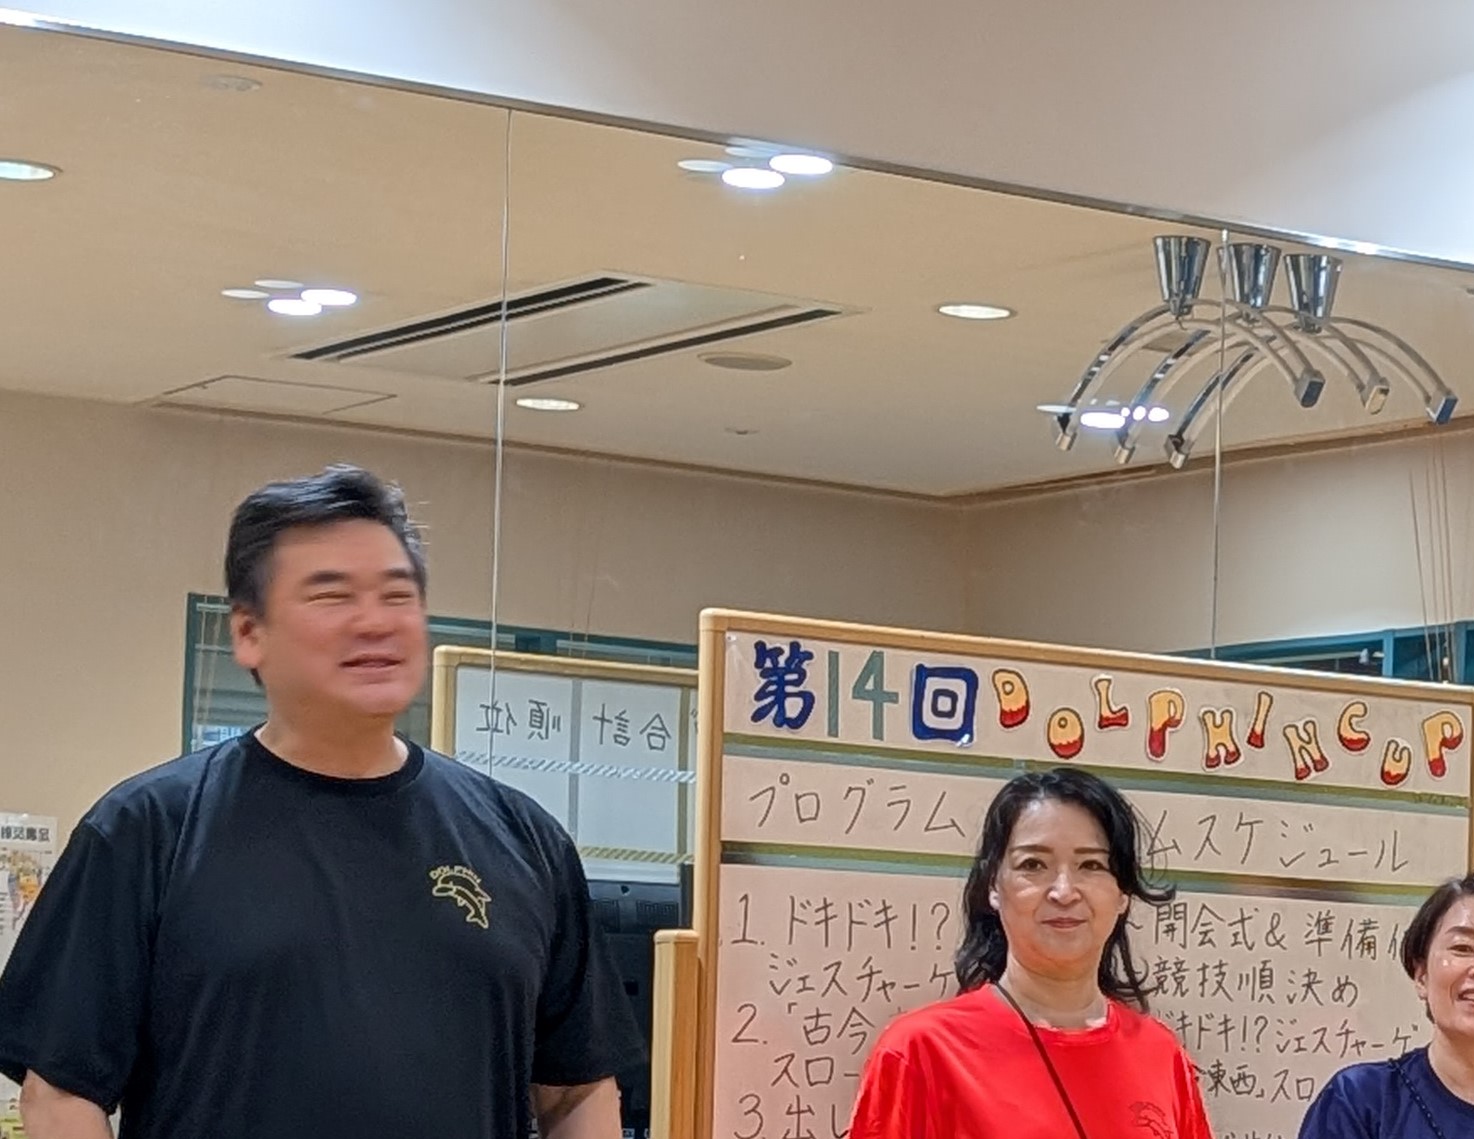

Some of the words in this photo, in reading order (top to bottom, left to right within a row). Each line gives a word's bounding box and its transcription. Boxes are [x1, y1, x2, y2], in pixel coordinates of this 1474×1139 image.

[750, 639, 979, 746] 第14回
[749, 772, 967, 838] プログラム
[787, 1002, 909, 1056] 「古今
